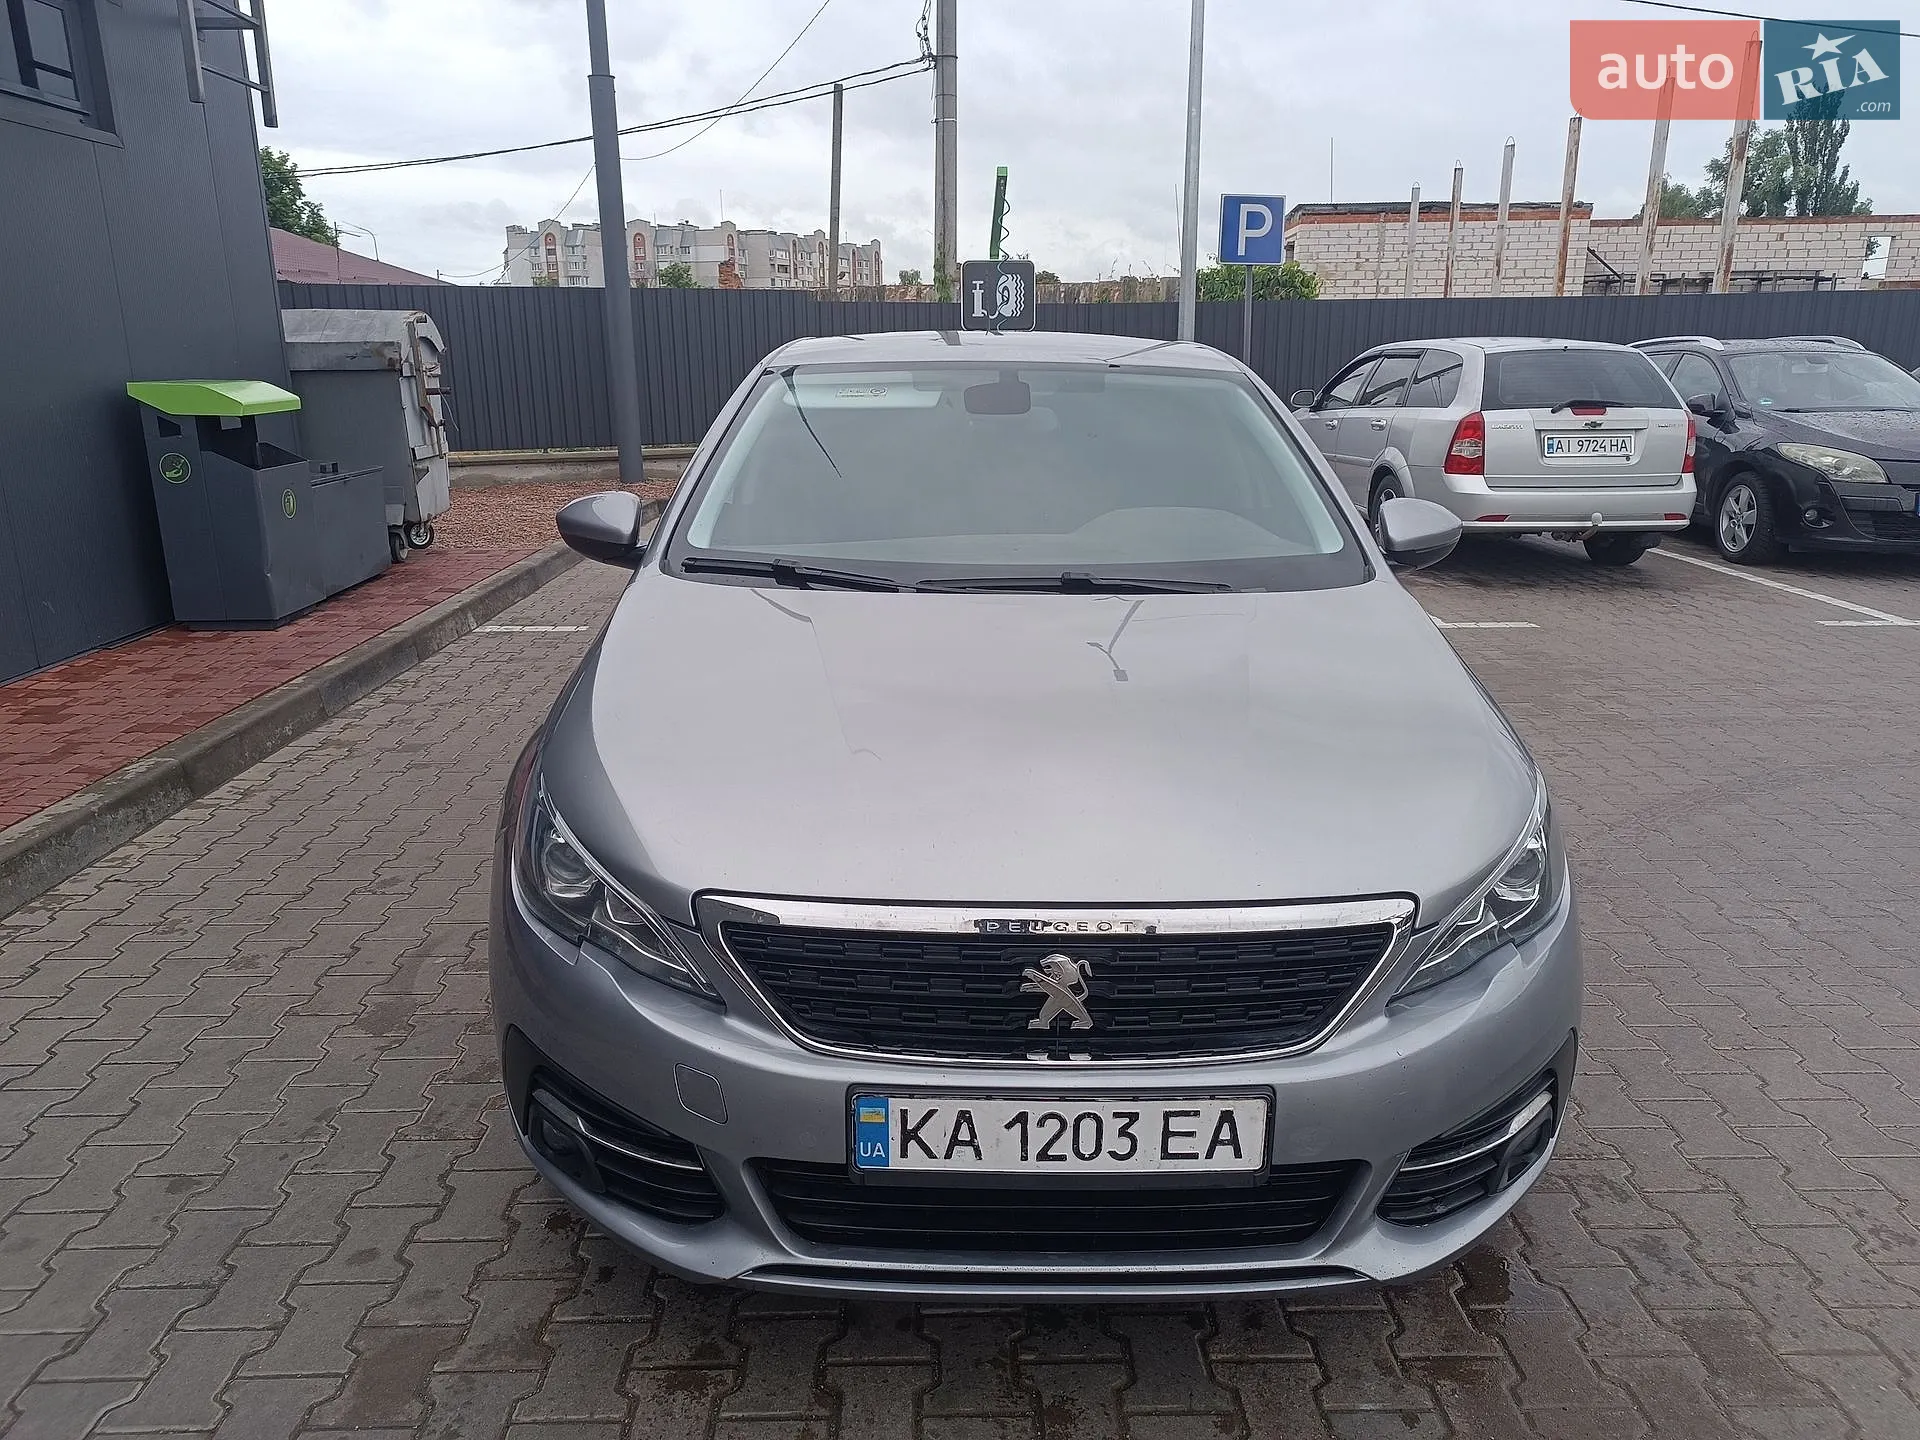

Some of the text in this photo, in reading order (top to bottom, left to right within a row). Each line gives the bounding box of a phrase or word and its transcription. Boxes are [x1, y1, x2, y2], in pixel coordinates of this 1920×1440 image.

[1237, 203, 1273, 256] P
[1555, 438, 1629, 453] AI 9724 HA
[985, 920, 1134, 932] PEUGEOT
[898, 1108, 1244, 1162] KA 1203 EA
[860, 1141, 886, 1158] UA
